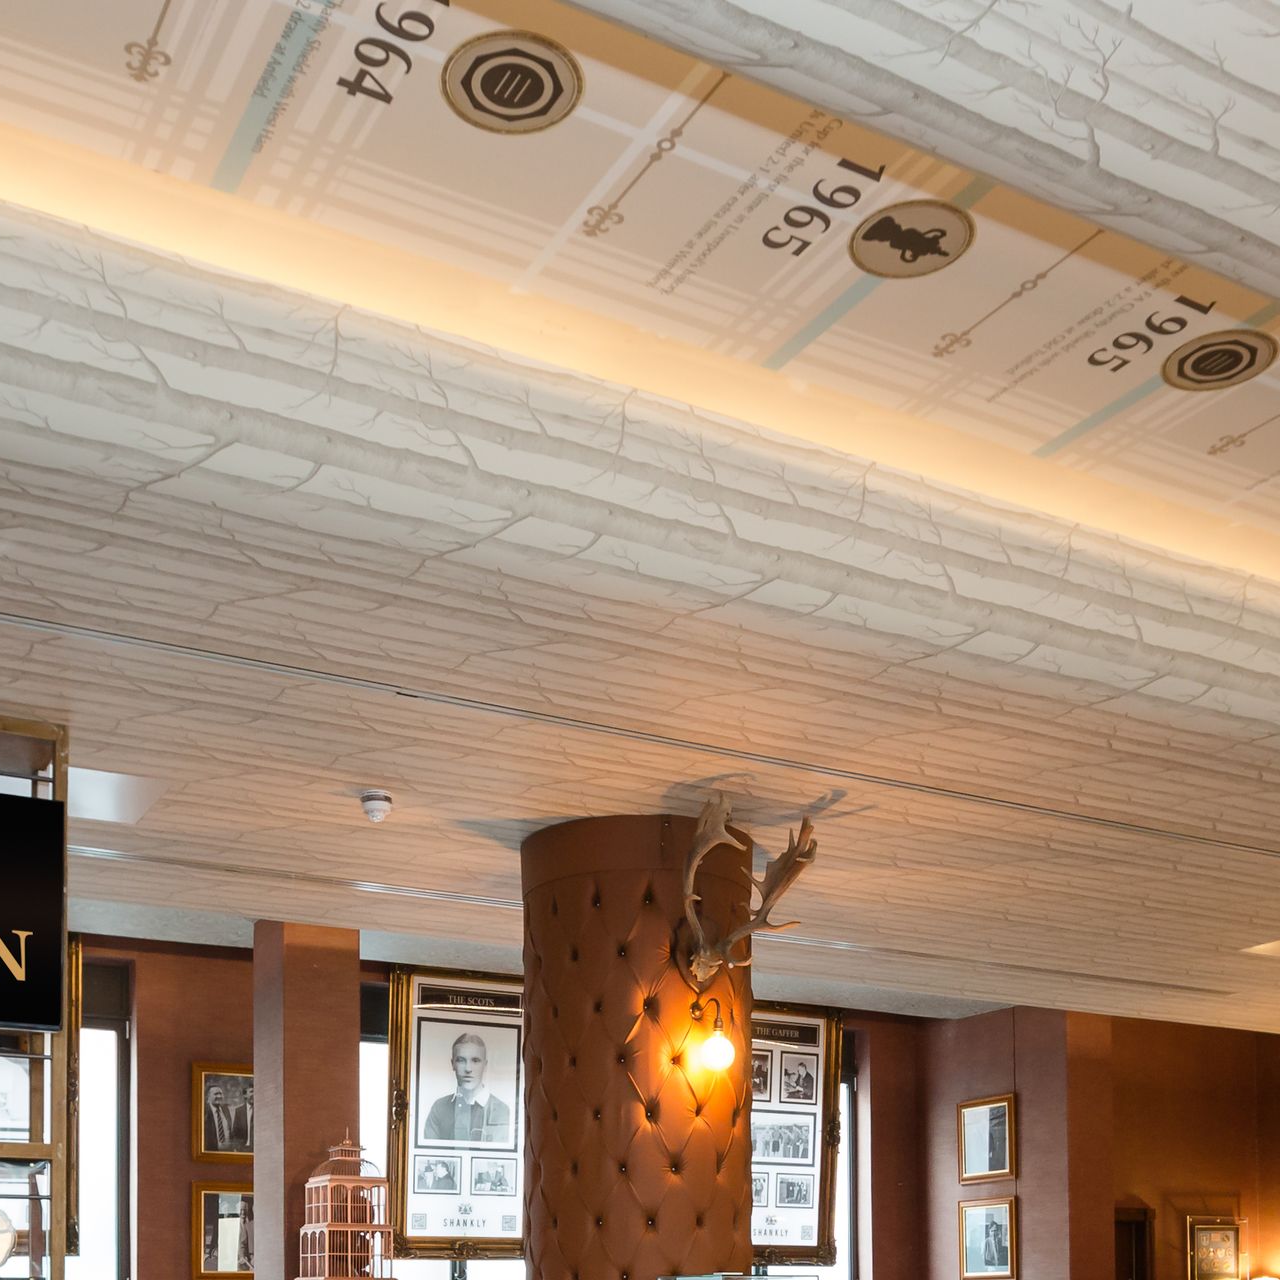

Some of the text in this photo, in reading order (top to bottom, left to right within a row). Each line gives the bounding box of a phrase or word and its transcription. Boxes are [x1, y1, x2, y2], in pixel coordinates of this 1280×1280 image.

[336, 0, 450, 105] 964
[762, 157, 886, 257] 1965
[1088, 294, 1217, 373] 1965
[448, 994, 495, 1007] THE SCOTS
[755, 1026, 800, 1038] THE GAFFER
[443, 1218, 486, 1228] SHANKLY
